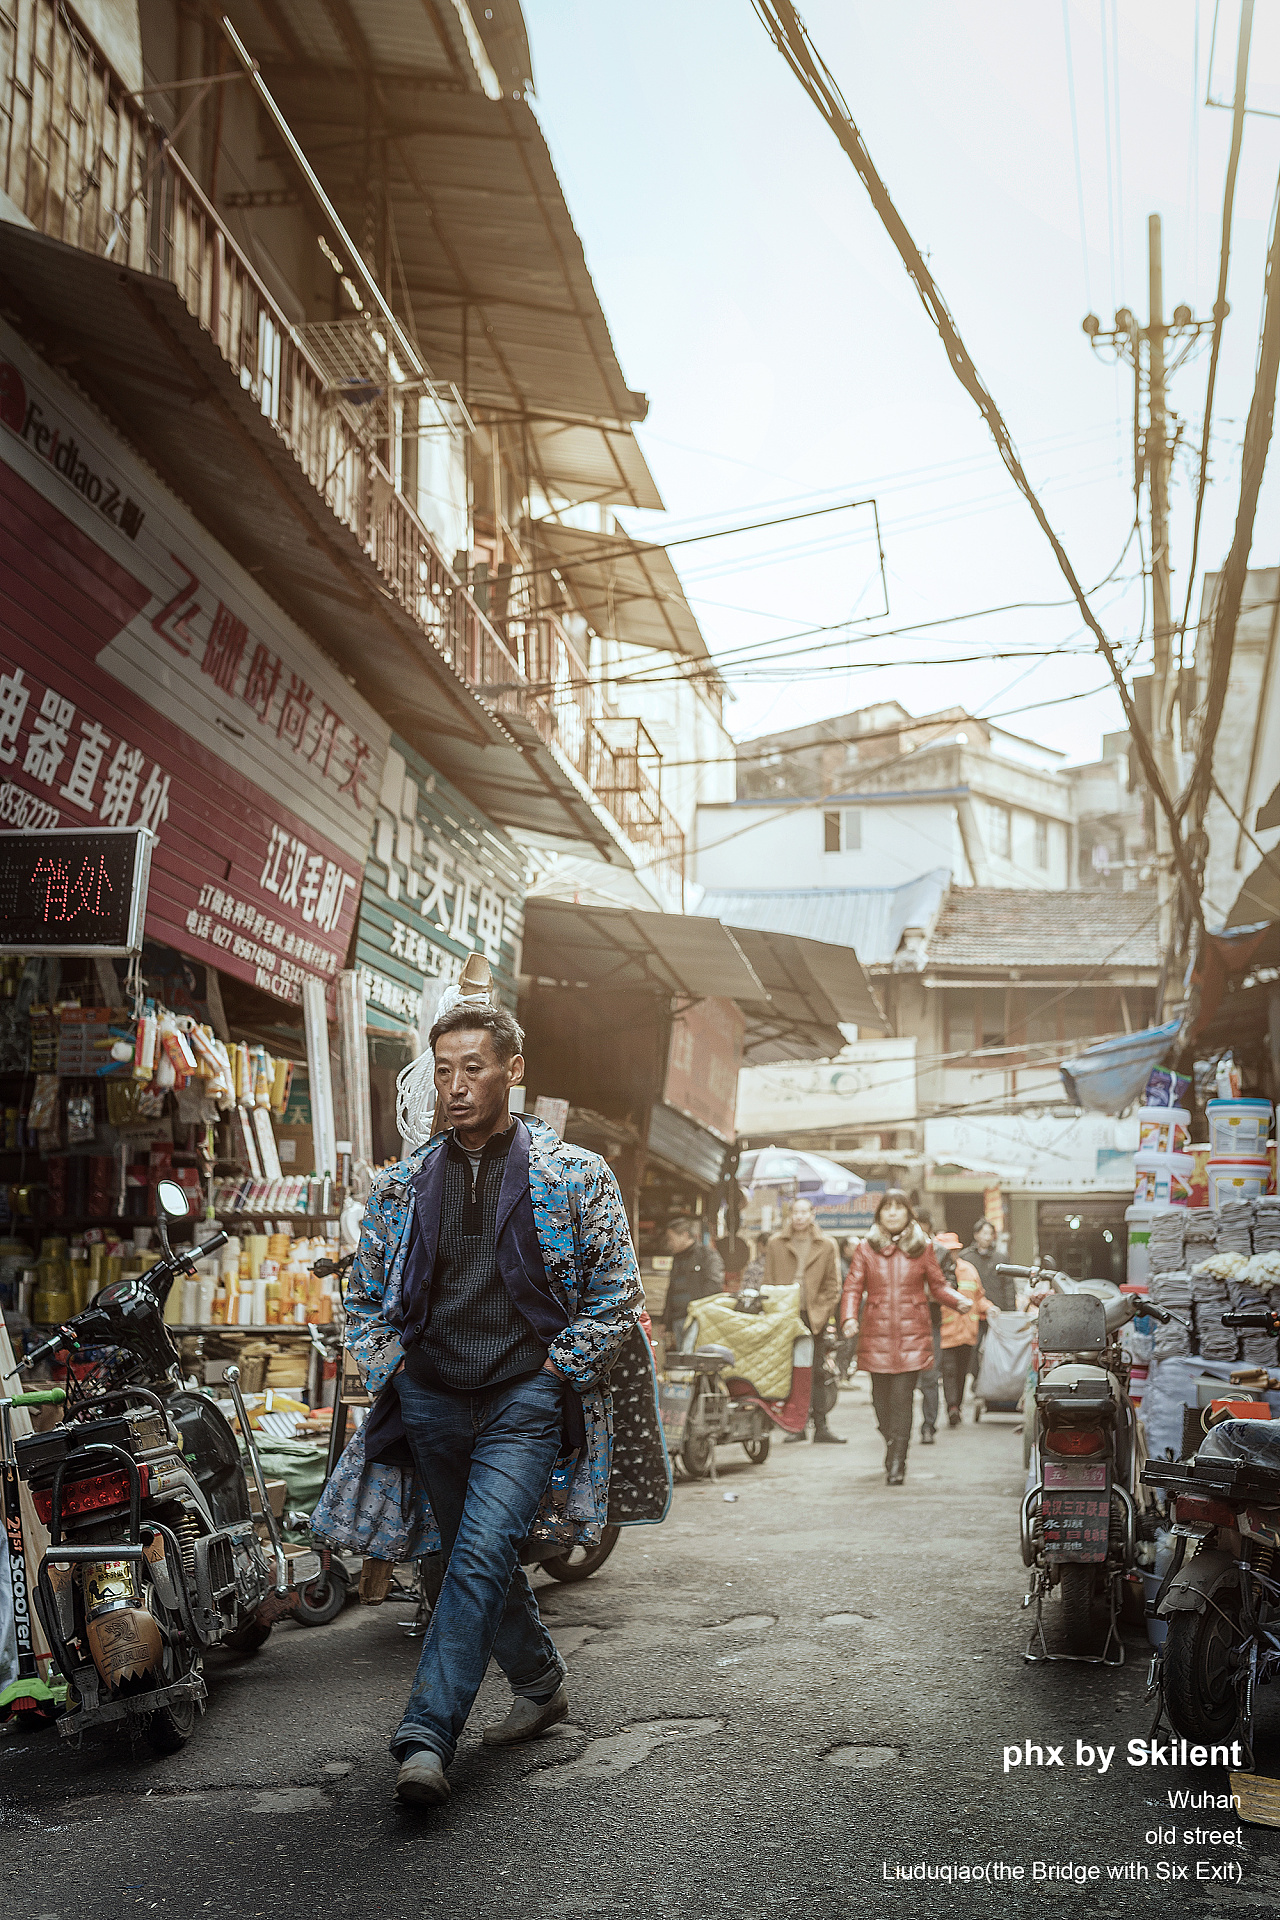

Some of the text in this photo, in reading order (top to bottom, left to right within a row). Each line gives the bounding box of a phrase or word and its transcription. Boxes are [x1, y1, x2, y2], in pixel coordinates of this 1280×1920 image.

[260, 823, 356, 933] 江汉毛刷厂
[1050, 1469, 1104, 1481] 五钻豹
[7, 1515, 22, 1552] 21st
